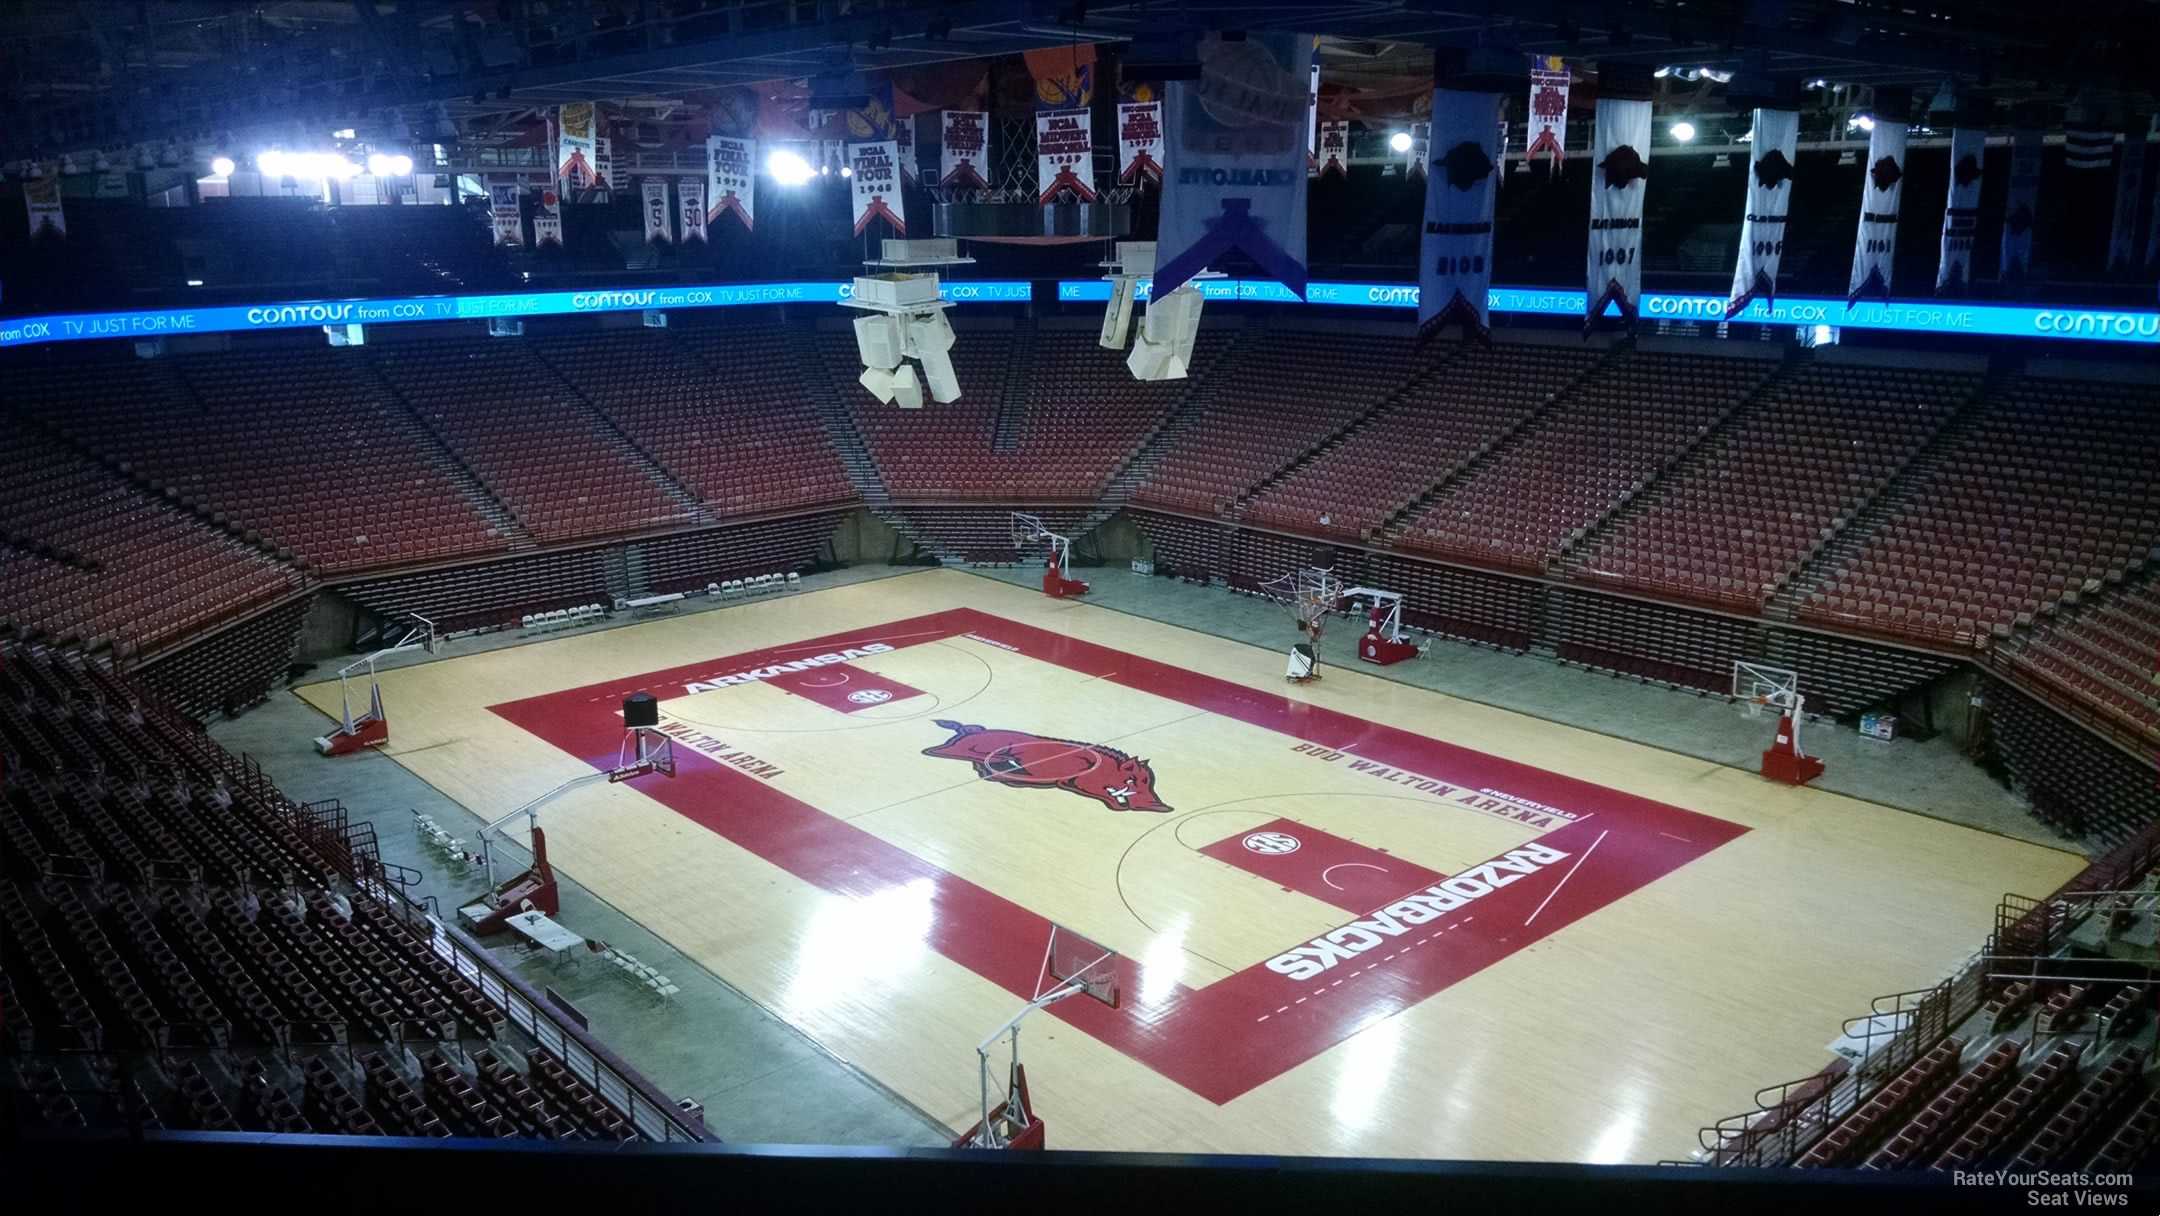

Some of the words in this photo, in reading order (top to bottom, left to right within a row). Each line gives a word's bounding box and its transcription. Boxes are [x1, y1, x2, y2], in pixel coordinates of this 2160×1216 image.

[1048, 118, 1079, 131] NCAA
[1039, 129, 1088, 144] MIDWEST
[1130, 139, 1154, 147] 1977
[720, 140, 744, 151] NCAA
[859, 146, 886, 156] NCAA
[714, 149, 750, 165] FINAL
[853, 155, 893, 170] FINAL
[715, 160, 749, 177] FOUR
[857, 168, 893, 182] FOUR
[685, 208, 702, 227] 50
[659, 292, 685, 305] from
[687, 291, 713, 304] COX
[719, 290, 734, 302] TV
[735, 288, 761, 301] JUST
[762, 287, 785, 300] FOR
[786, 287, 804, 299] ME
[952, 286, 979, 298] COX
[987, 286, 1003, 298] TV
[1004, 286, 1032, 298] JUST
[1061, 286, 1080, 298] ME
[1205, 286, 1232, 298] from
[1233, 285, 1258, 297] COX
[1263, 286, 1276, 298] TV
[1277, 286, 1297, 299] JUS
[1306, 287, 1321, 299] OR
[1322, 287, 1338, 300] ME
[1368, 287, 1419, 304] CONTO
[434, 303, 452, 315] TV
[454, 301, 486, 315] JUST
[488, 299, 515, 312] FOR
[516, 298, 539, 312] ME
[1510, 296, 1525, 308] TV
[1526, 296, 1556, 309] JUST
[1557, 297, 1585, 311] FOR
[358, 305, 390, 319] from
[393, 304, 425, 318] COX
[1791, 305, 1827, 321] COX
[1839, 307, 1860, 323] TV
[1861, 309, 1903, 325] JUST
[1906, 310, 1943, 326] FOR
[1946, 311, 1974, 328] ME
[0, 329, 21, 341] rom
[23, 323, 51, 338] COX
[62, 320, 84, 335] TV
[89, 318, 129, 334] JUST
[132, 316, 168, 331] FOR
[171, 314, 196, 329] ME
[2034, 312, 2160, 337] CONTOU
[681, 643, 895, 695] ARKANSAS
[851, 691, 890, 704] SEC
[659, 714, 732, 754] WALTON
[718, 751, 785, 780] ARENA
[1290, 743, 1346, 762] BUD
[1348, 759, 1457, 797] WALTON
[1456, 793, 1555, 829] ARENA
[1480, 787, 1577, 820] #NEVERYIELD
[1248, 834, 1297, 853] SEC
[1264, 842, 1572, 981] RAZORBACKS
